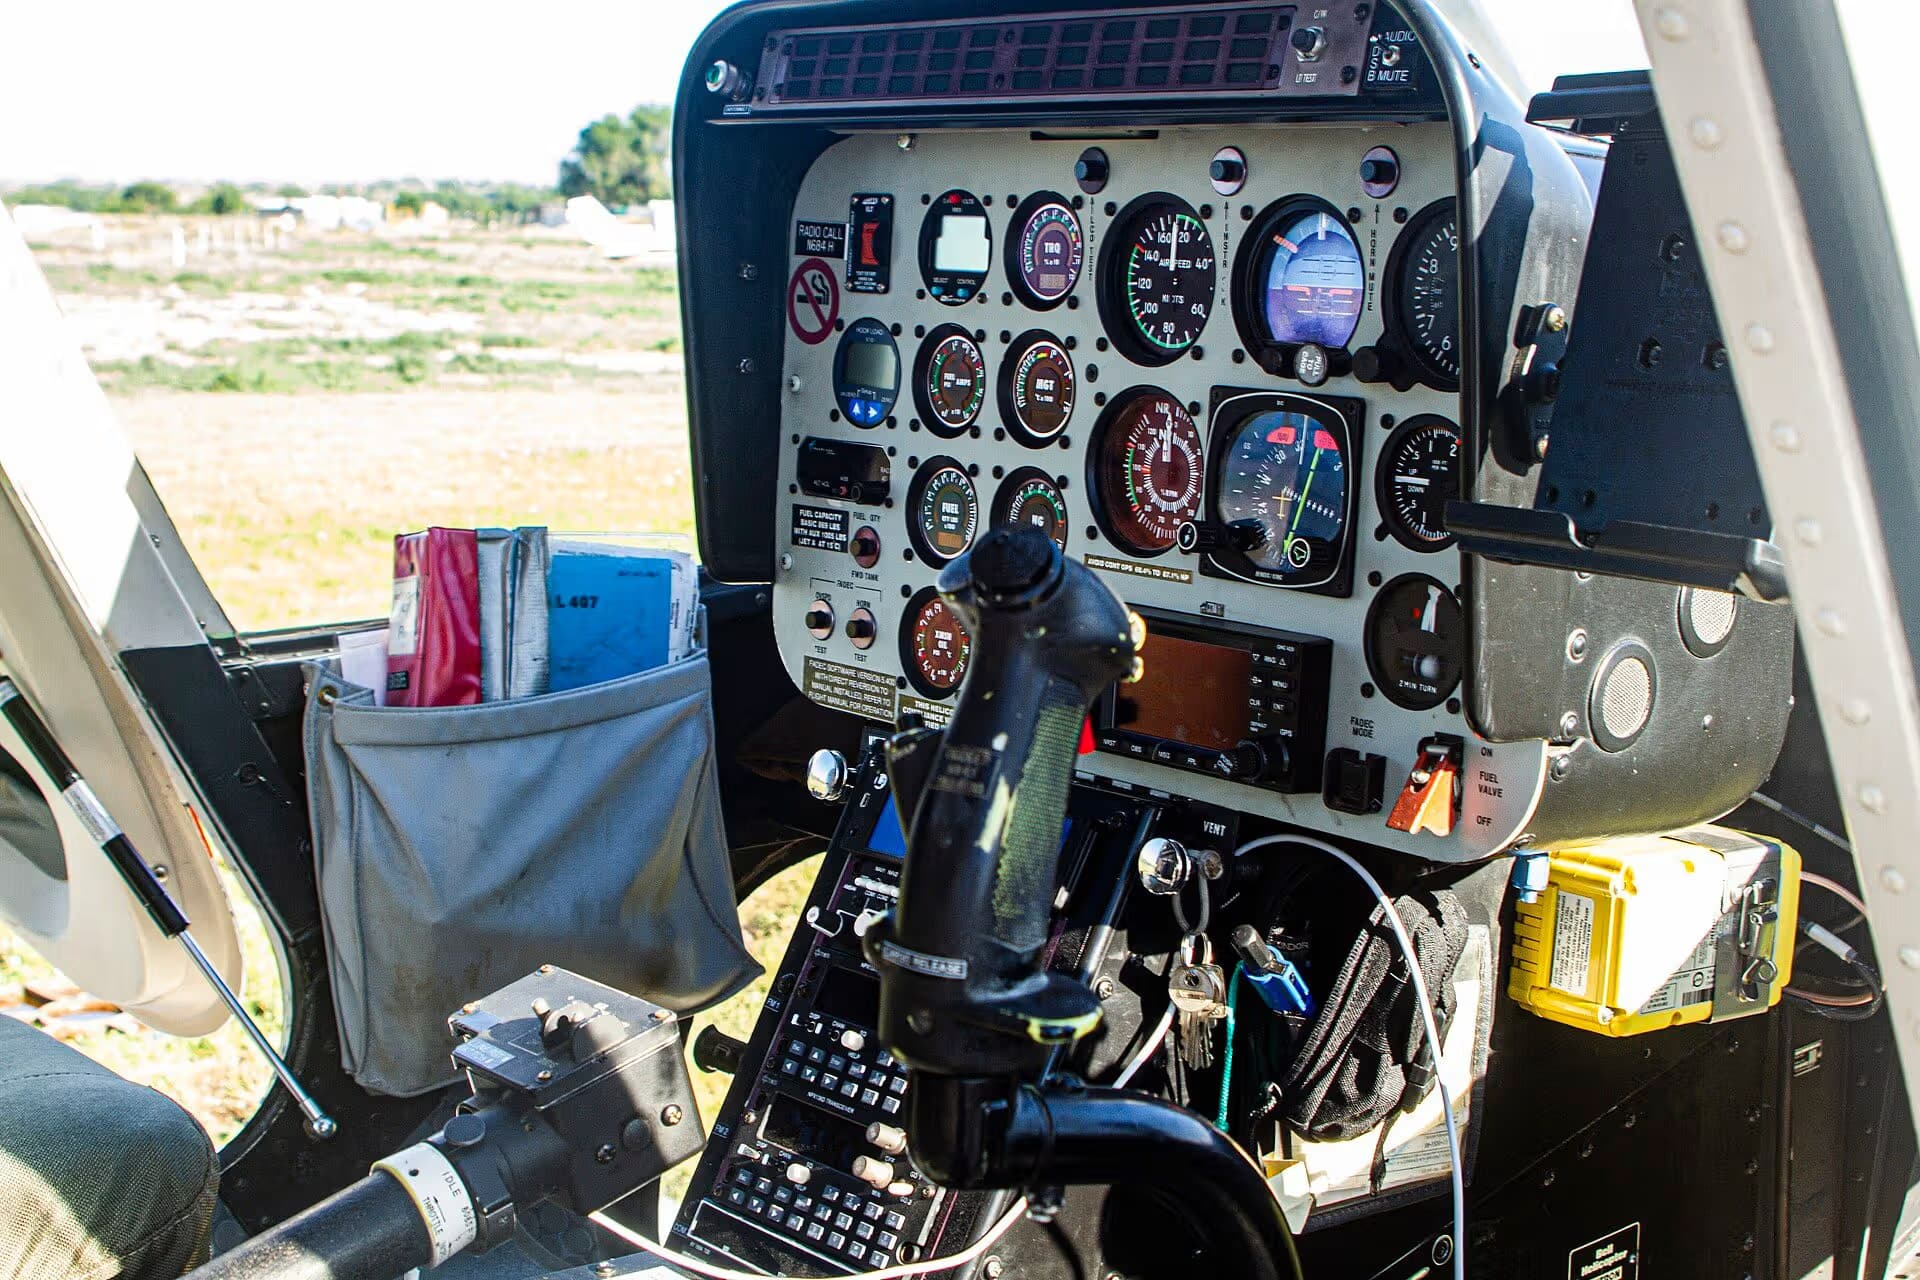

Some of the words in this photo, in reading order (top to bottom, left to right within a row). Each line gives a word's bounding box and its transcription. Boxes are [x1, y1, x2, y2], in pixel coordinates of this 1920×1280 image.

[1378, 70, 1409, 81] MUTE
[799, 224, 821, 238] RADIO
[823, 226, 844, 240] CALL
[1158, 232, 1172, 243] 160
[1178, 232, 1190, 243] 20
[1044, 242, 1061, 254] TRQ
[1369, 229, 1377, 268] HORN
[1450, 235, 1458, 251] 9
[1144, 250, 1160, 262] 140
[1195, 258, 1208, 270] 40
[1429, 258, 1438, 274] 8
[1138, 278, 1152, 289] 120
[1367, 273, 1376, 312] MUTE
[1144, 303, 1158, 314] 100
[1191, 304, 1203, 315] 60
[1163, 322, 1175, 333] 80
[1426, 314, 1435, 329] 7
[1441, 335, 1451, 350] 6
[1312, 354, 1322, 376] PULL
[1036, 378, 1055, 391] MGT
[1155, 402, 1170, 414] NR
[1275, 449, 1286, 464] 30
[1449, 444, 1457, 457] 2
[1261, 473, 1272, 485] W
[1408, 485, 1424, 494] DOWN
[942, 502, 959, 514] FUEL
[800, 509, 813, 517] FUEL
[814, 511, 842, 521] CAPACITY
[853, 512, 866, 521] FUEL
[851, 570, 864, 579] FWD
[865, 572, 879, 581] TANK
[1152, 569, 1160, 577] TO
[836, 580, 854, 590] FADEC
[569, 595, 599, 608] 407
[856, 600, 871, 608] HORN
[814, 645, 827, 654] TEST
[854, 653, 868, 662] TEST
[857, 671, 880, 682] VERSION
[1272, 680, 1288, 689] MENU
[1404, 681, 1416, 689] MIN
[1419, 683, 1437, 693] TURN
[808, 690, 826, 701] FLIGHT
[827, 695, 849, 707] MANUAL
[849, 700, 861, 710] FOR
[861, 704, 893, 718] OPERATION
[863, 693, 882, 705] REFER
[915, 700, 930, 710] THIS
[1249, 698, 1261, 706] CLR
[1350, 716, 1375, 729] FADEC
[1280, 728, 1293, 737] GPS
[1352, 728, 1374, 739] MODE
[1481, 747, 1493, 757] ON
[1479, 771, 1499, 784] FUEL
[1478, 784, 1503, 798] VALVE
[1476, 815, 1492, 826] OFF
[1203, 821, 1226, 836] VENT
[441, 1171, 462, 1197] IDLE
[424, 1196, 444, 1233] THROTTLE
